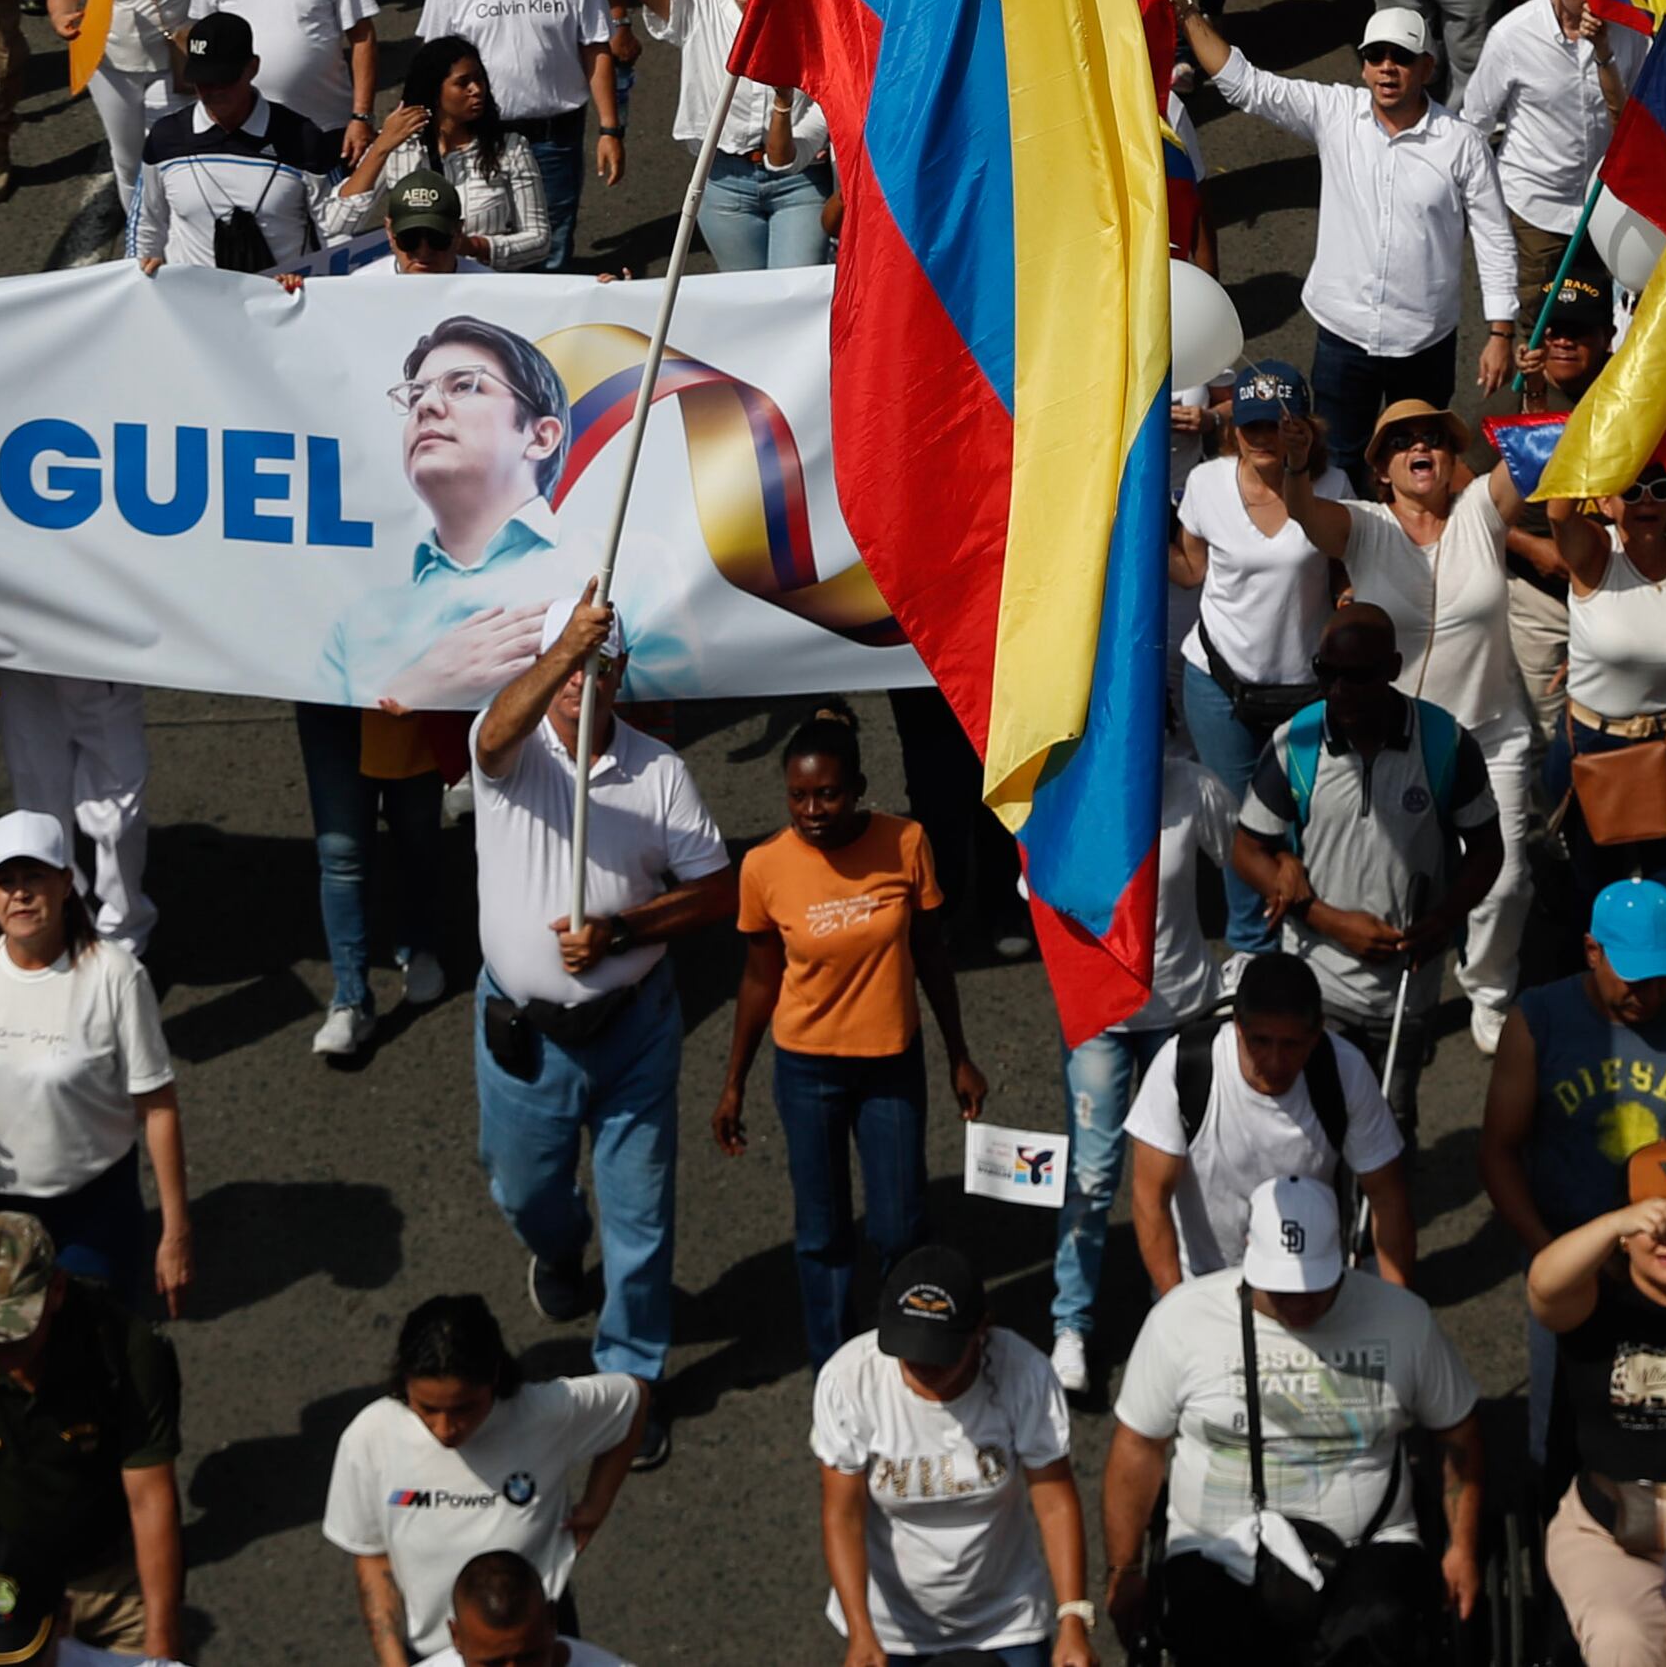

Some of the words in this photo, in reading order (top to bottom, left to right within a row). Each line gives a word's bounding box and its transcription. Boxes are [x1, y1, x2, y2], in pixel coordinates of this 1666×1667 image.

[476, 1, 525, 18] Calvin
[402, 188, 439, 202] AERO
[1542, 279, 1599, 297] VERANO
[1281, 1220, 1305, 1253] SD
[434, 1488, 498, 1511] Power
